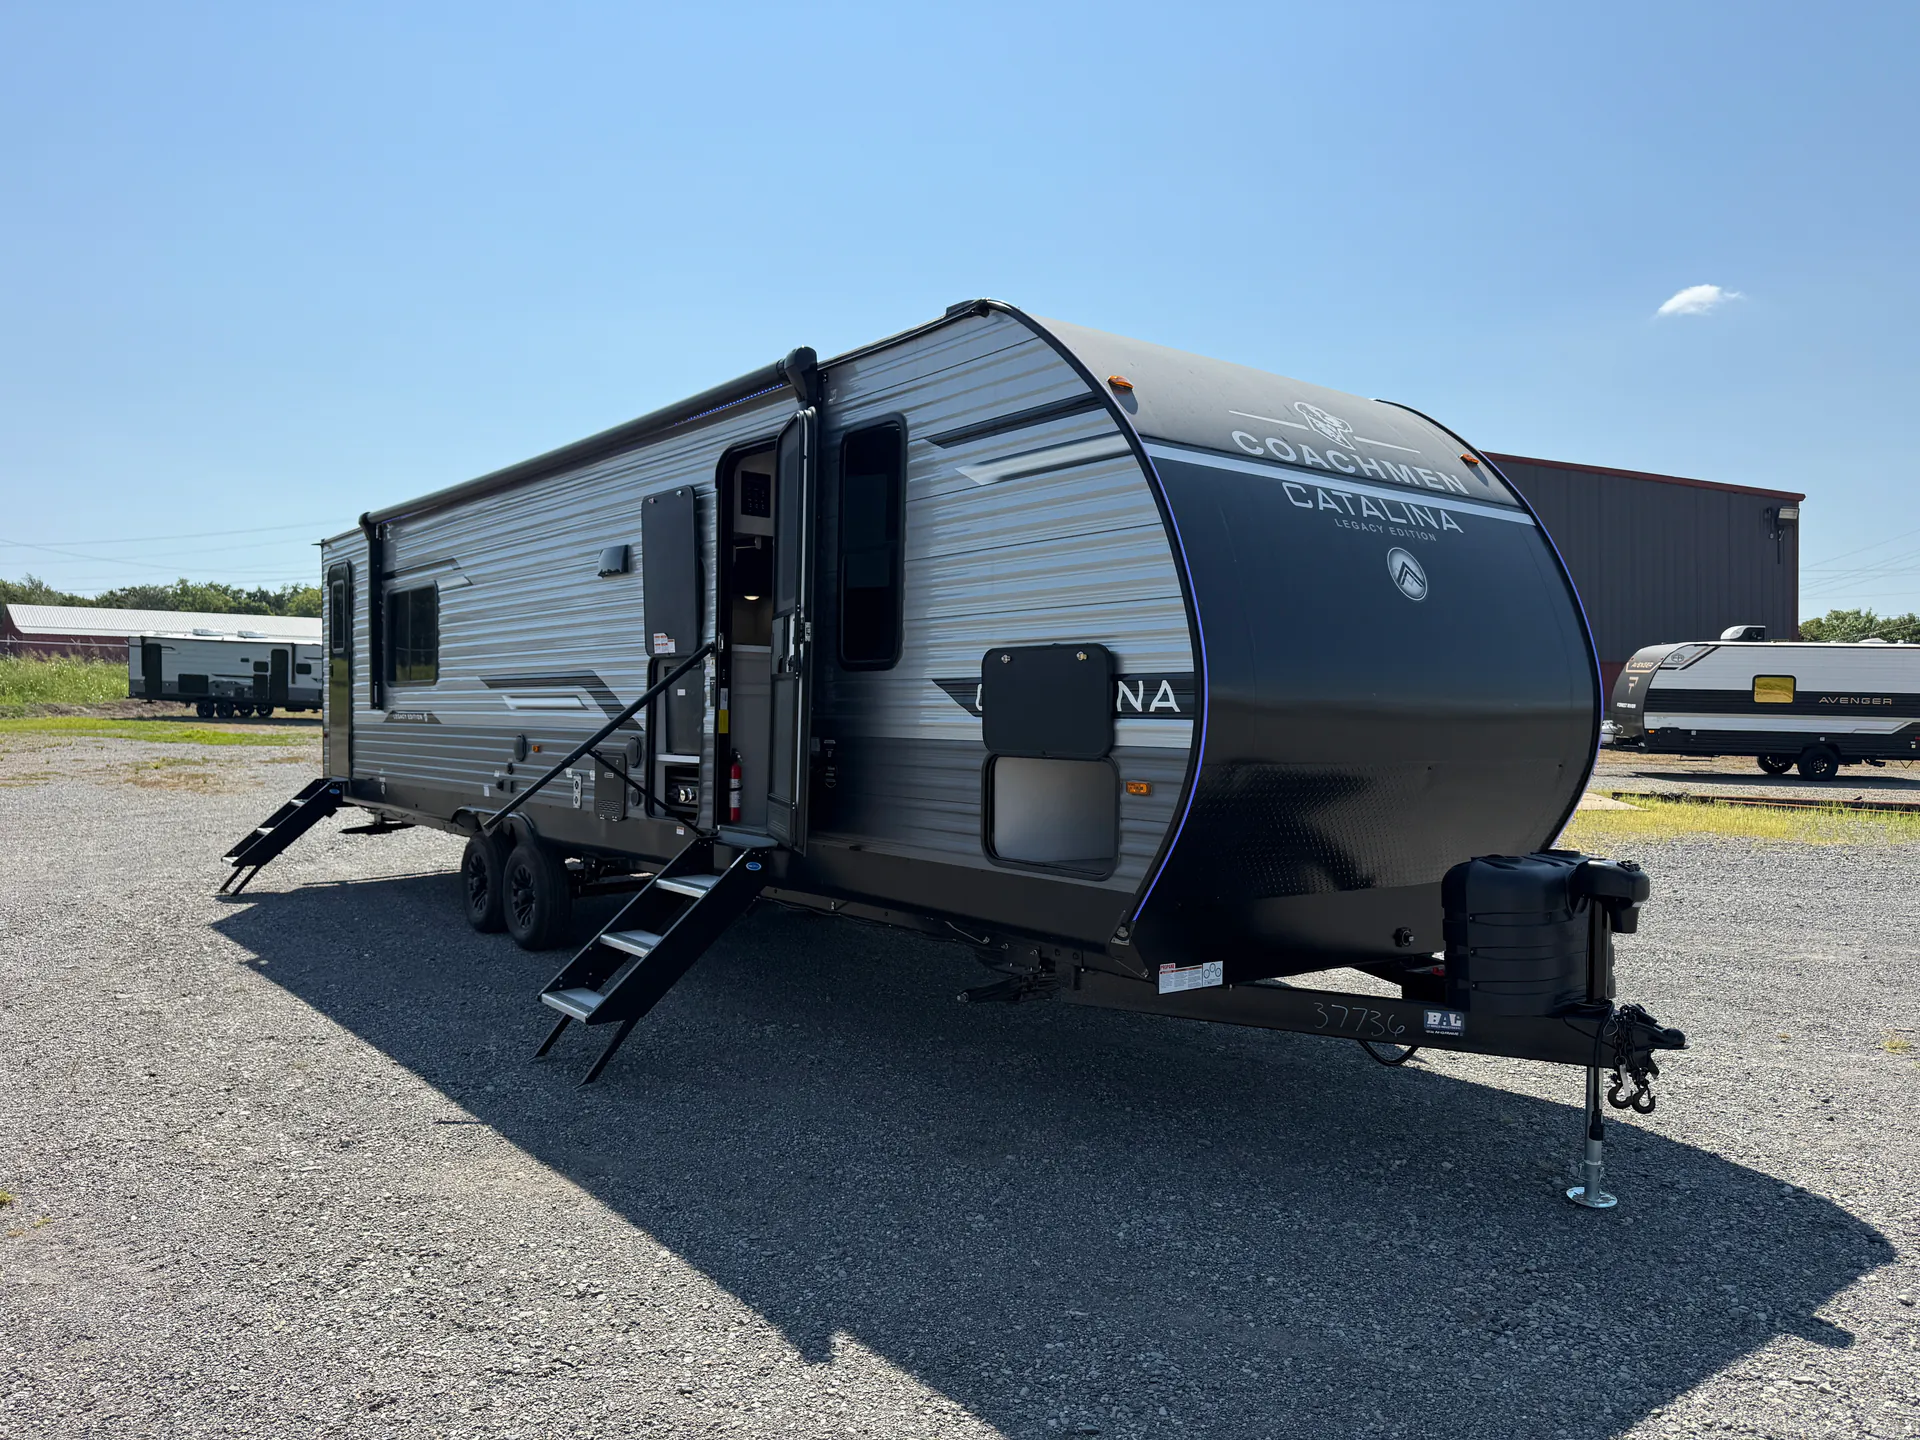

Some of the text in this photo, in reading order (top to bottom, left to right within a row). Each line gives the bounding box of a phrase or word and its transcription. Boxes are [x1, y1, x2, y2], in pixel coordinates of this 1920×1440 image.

[1231, 430, 1470, 495] COACHMEN
[1282, 481, 1464, 533] CATALINA
[1334, 518, 1437, 542] LEGACY EDITION
[1818, 696, 1893, 706] AVENGER
[1313, 1002, 1406, 1037] 37736
